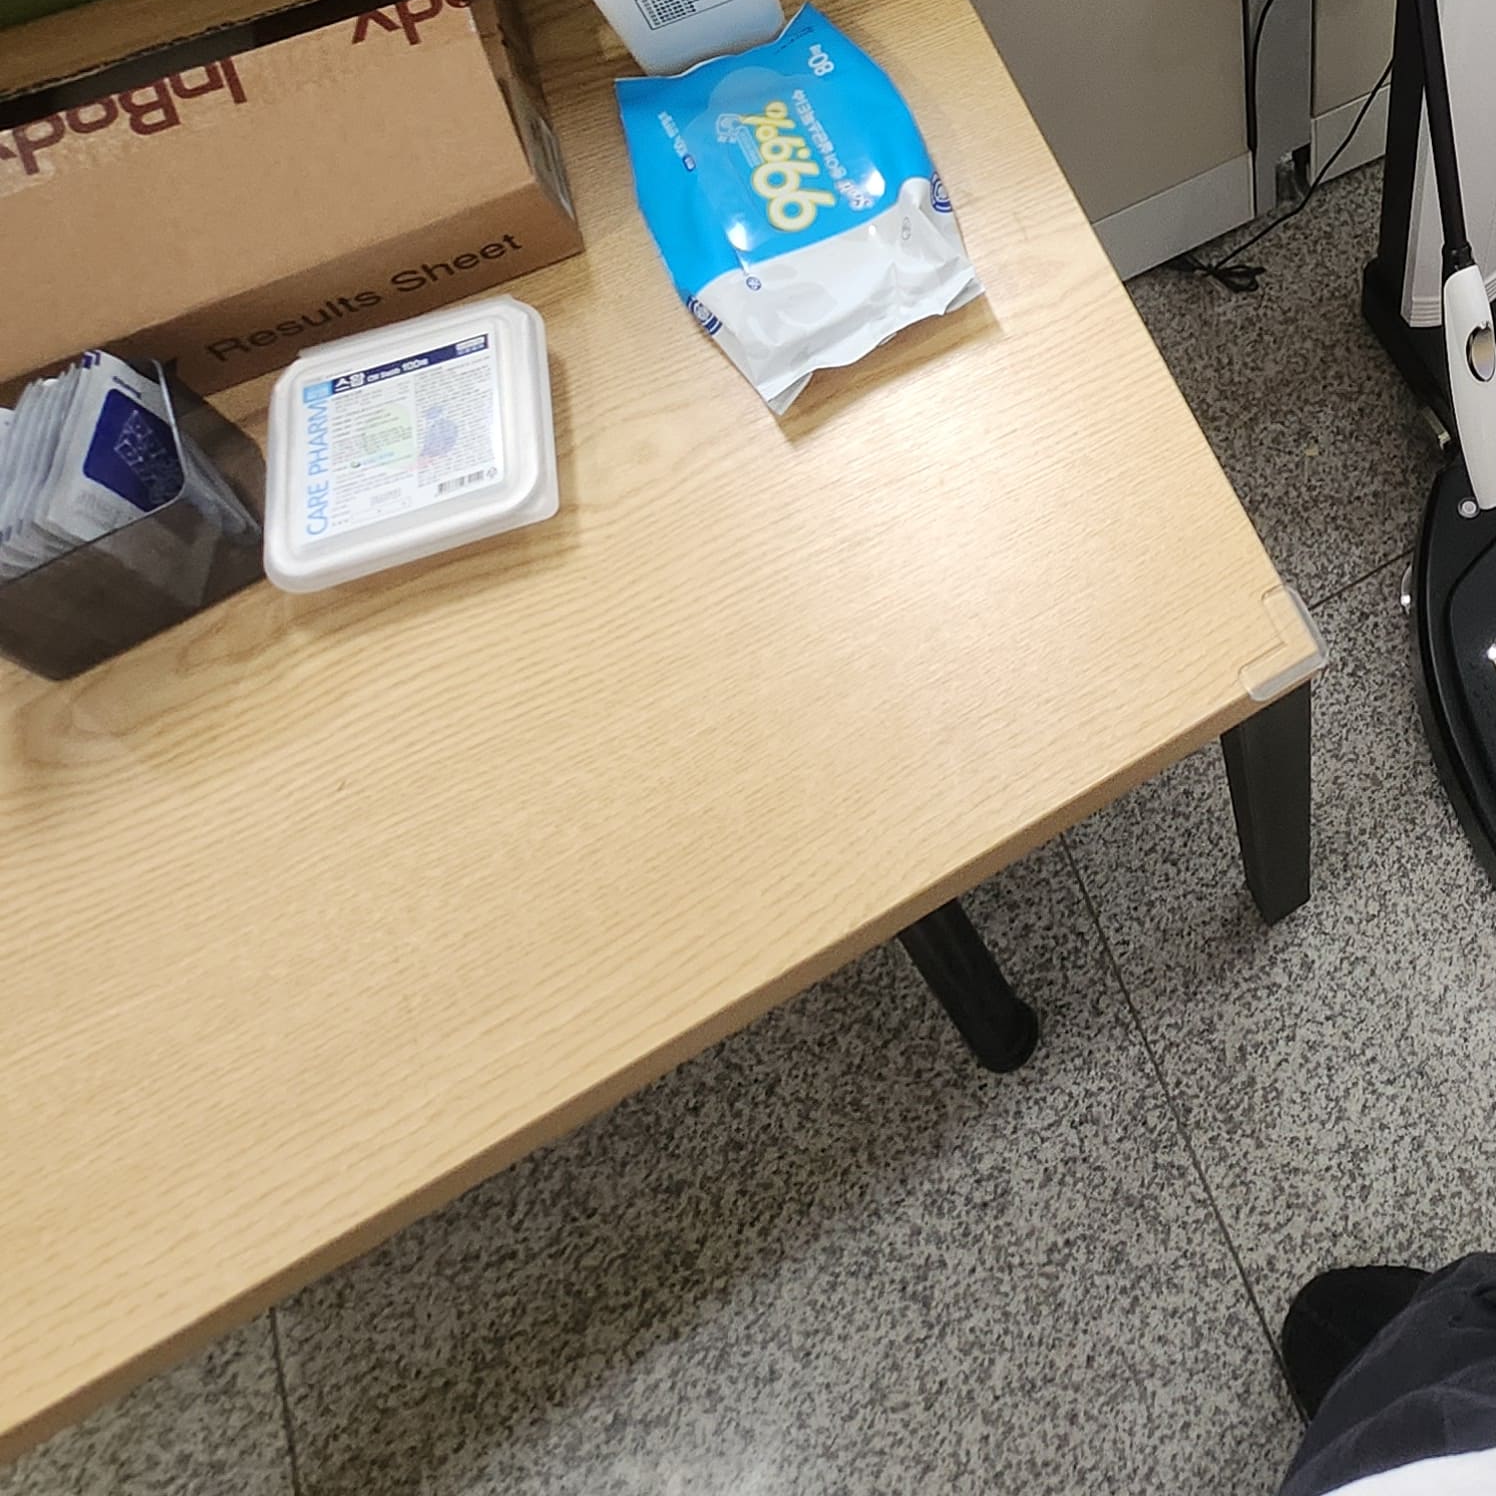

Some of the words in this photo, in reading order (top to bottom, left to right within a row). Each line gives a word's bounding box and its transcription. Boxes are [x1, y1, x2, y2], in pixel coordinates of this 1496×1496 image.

[738, 101, 837, 233] 99.9%
[206, 290, 381, 362] Results
[391, 233, 522, 291] Sheet
[306, 479, 330, 536] CARE
